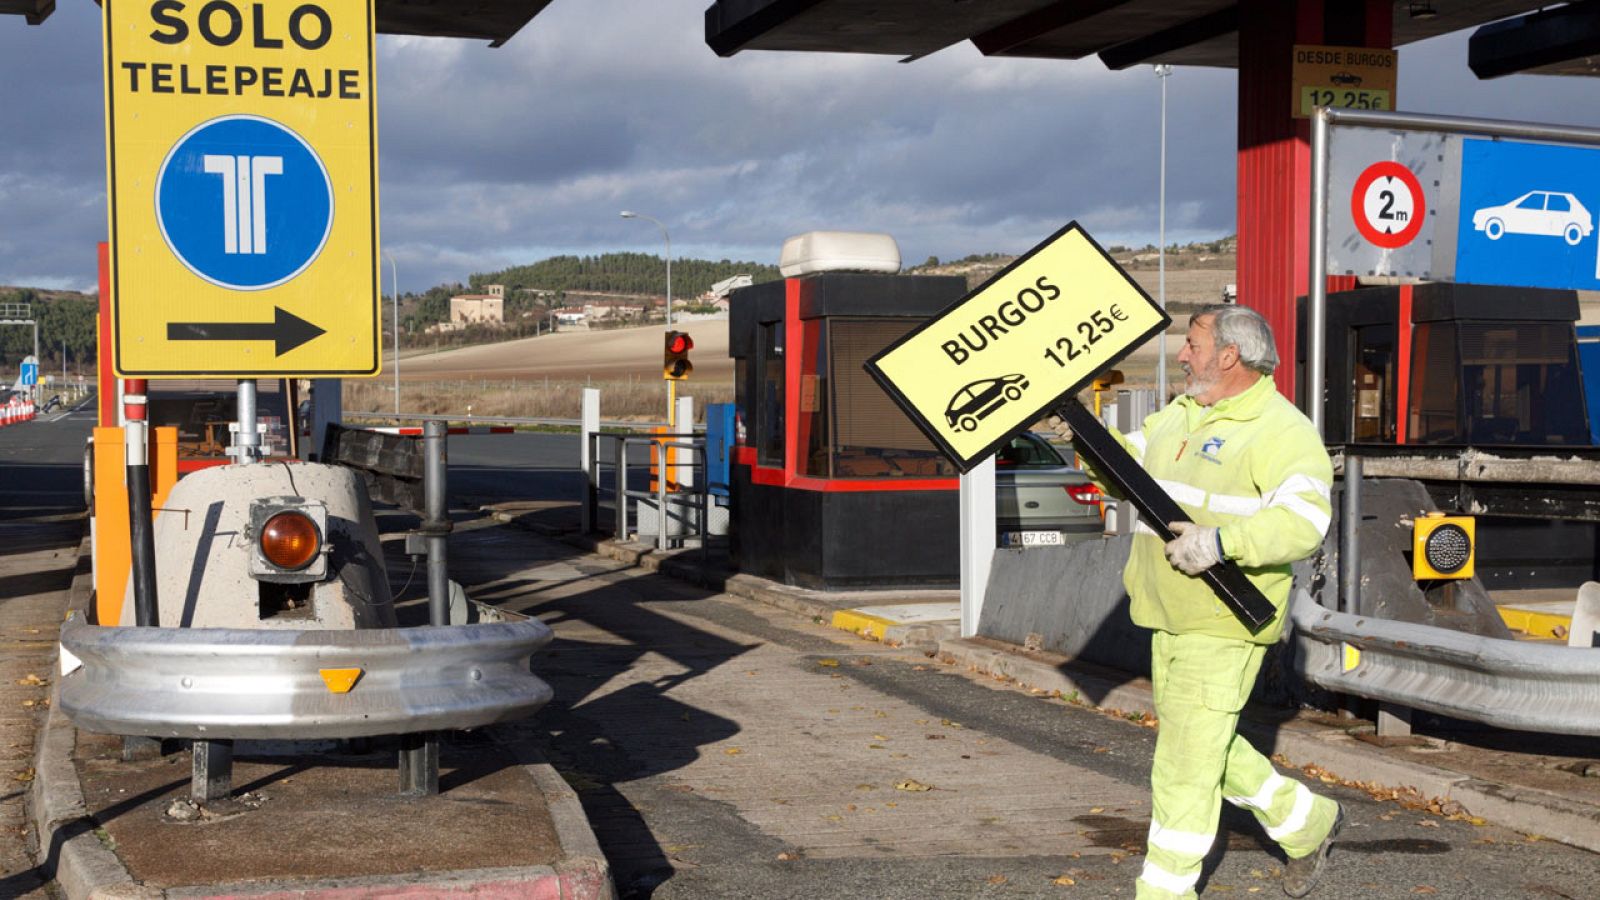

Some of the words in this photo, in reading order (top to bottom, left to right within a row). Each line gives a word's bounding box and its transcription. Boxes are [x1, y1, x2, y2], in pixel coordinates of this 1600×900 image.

[149, 0, 333, 50] SOLO
[121, 61, 361, 100] TELEPEAJE
[1297, 50, 1342, 65] DESDE
[1346, 52, 1393, 68] BURGOS
[1310, 89, 1383, 111] 1225€
[941, 275, 1061, 366] BURGOS
[1043, 303, 1129, 368] 12,25€
